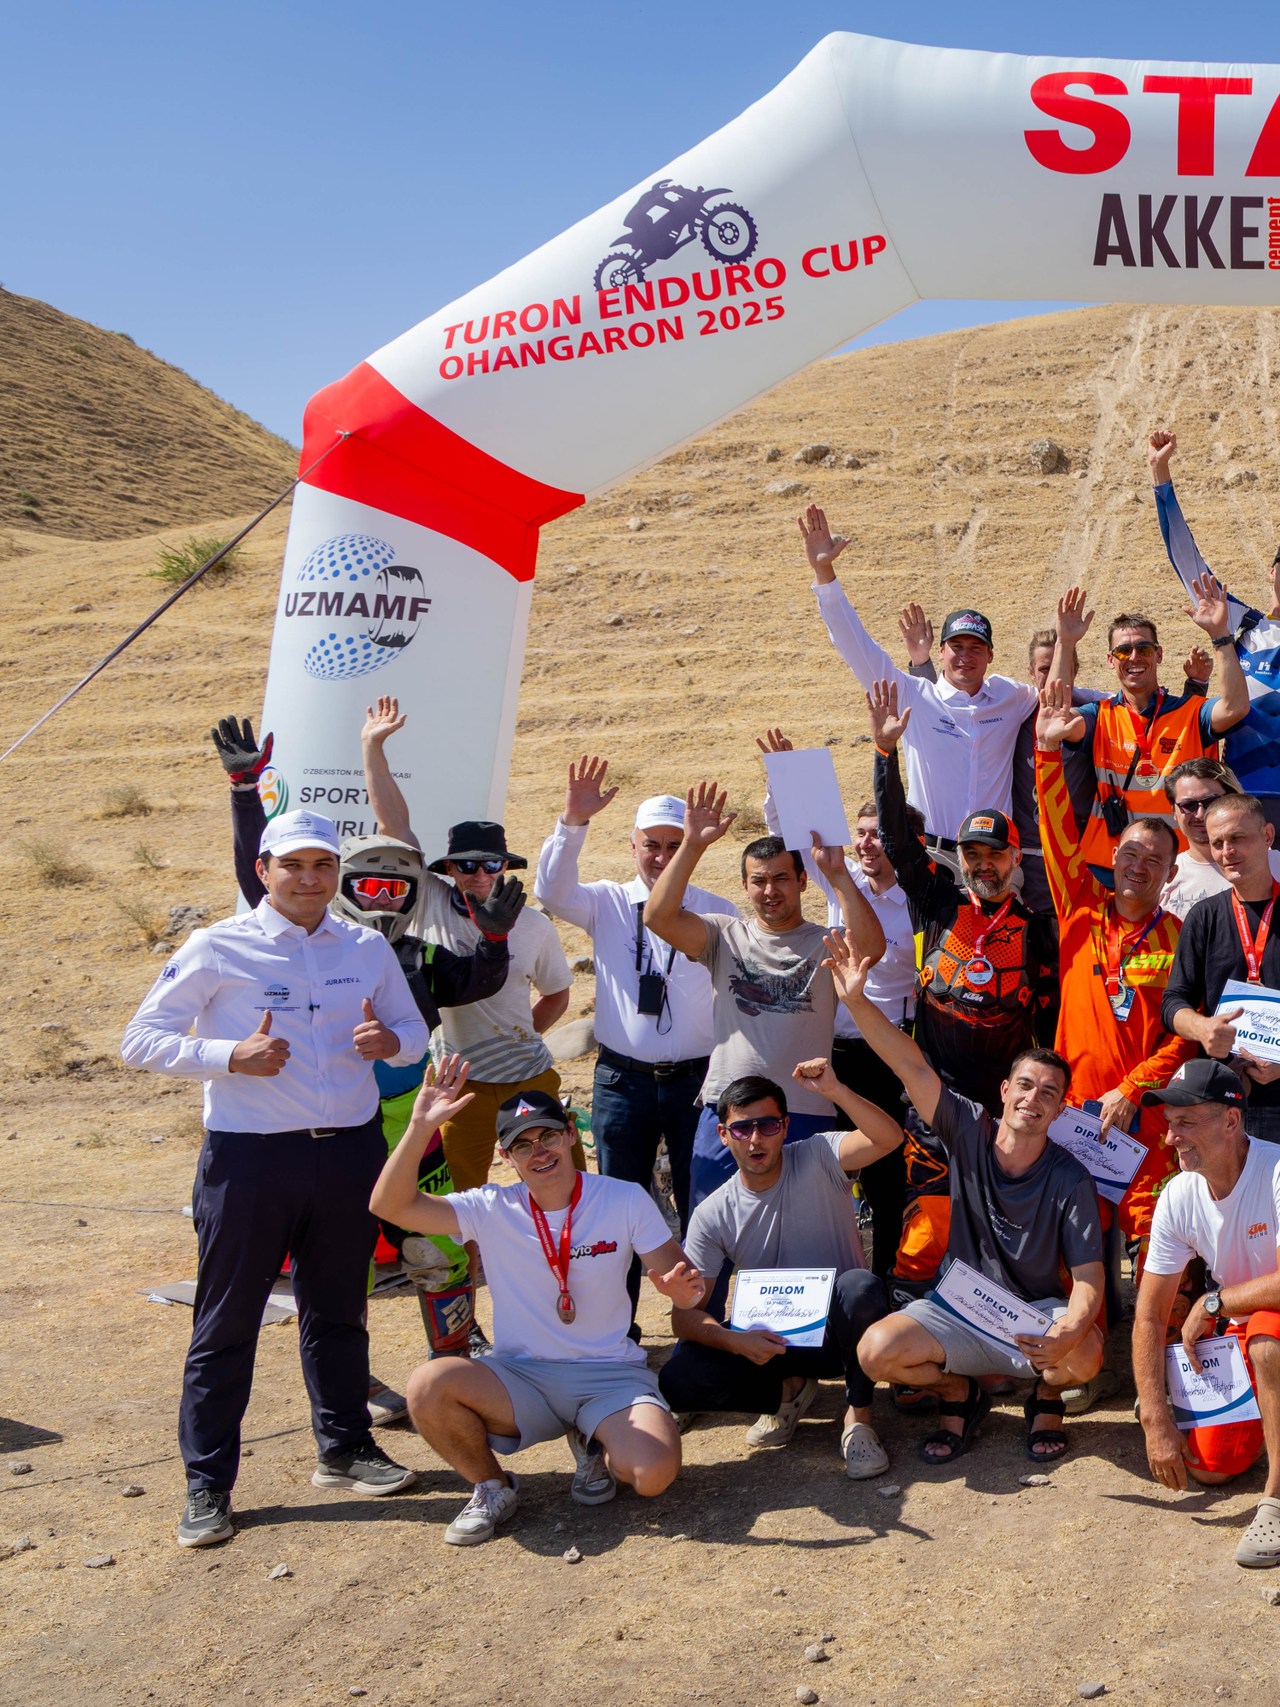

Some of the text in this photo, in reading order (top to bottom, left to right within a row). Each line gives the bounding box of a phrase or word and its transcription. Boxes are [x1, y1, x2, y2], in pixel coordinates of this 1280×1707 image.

[442, 234, 887, 350] TURON ENDURO CUP
[439, 296, 785, 380] OHANGARON 2025
[284, 591, 432, 622] UZMAMF
[324, 977, 354, 986] JURAYEV
[1248, 1222, 1267, 1235] KTM
[760, 1286, 805, 1295] DIPLOM
[973, 1287, 1019, 1322] DIPLOM
[1182, 1358, 1220, 1372] DIOM
